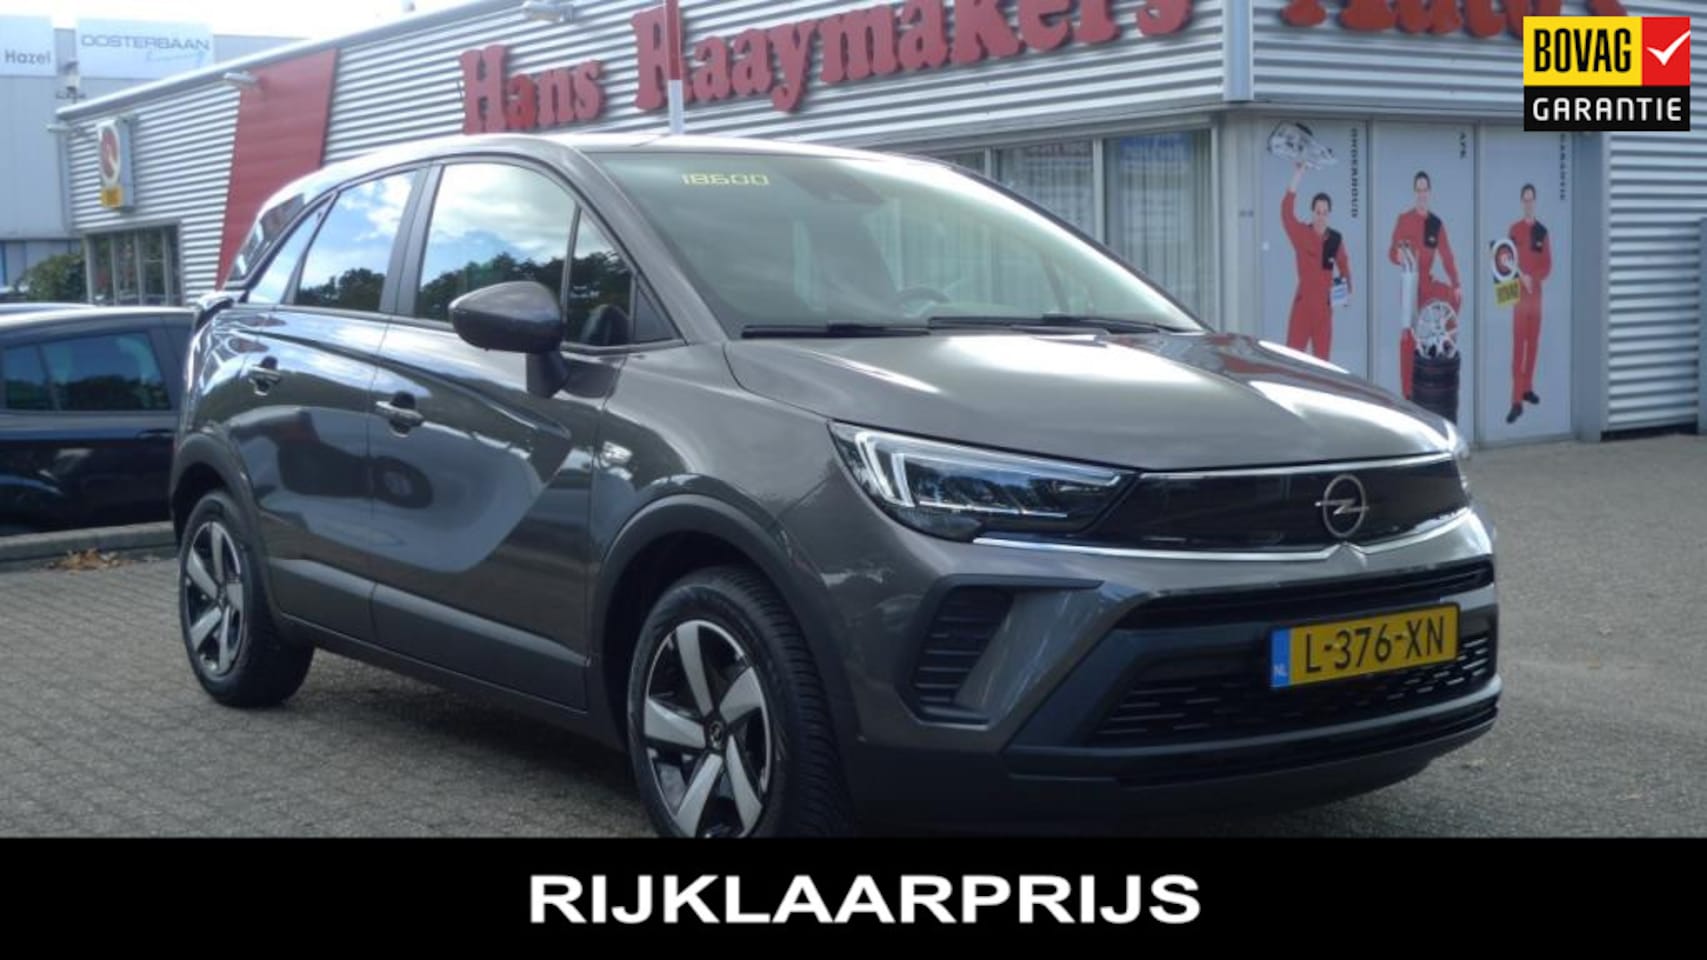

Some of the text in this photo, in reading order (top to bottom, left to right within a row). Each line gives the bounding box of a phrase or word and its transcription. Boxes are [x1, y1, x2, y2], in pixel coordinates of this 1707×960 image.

[81, 33, 210, 51] OOSTERBAAN
[4, 49, 51, 65] Hazel
[458, 43, 606, 135] Hans
[681, 173, 771, 186] 18600
[1305, 615, 1445, 674] L-376-XN
